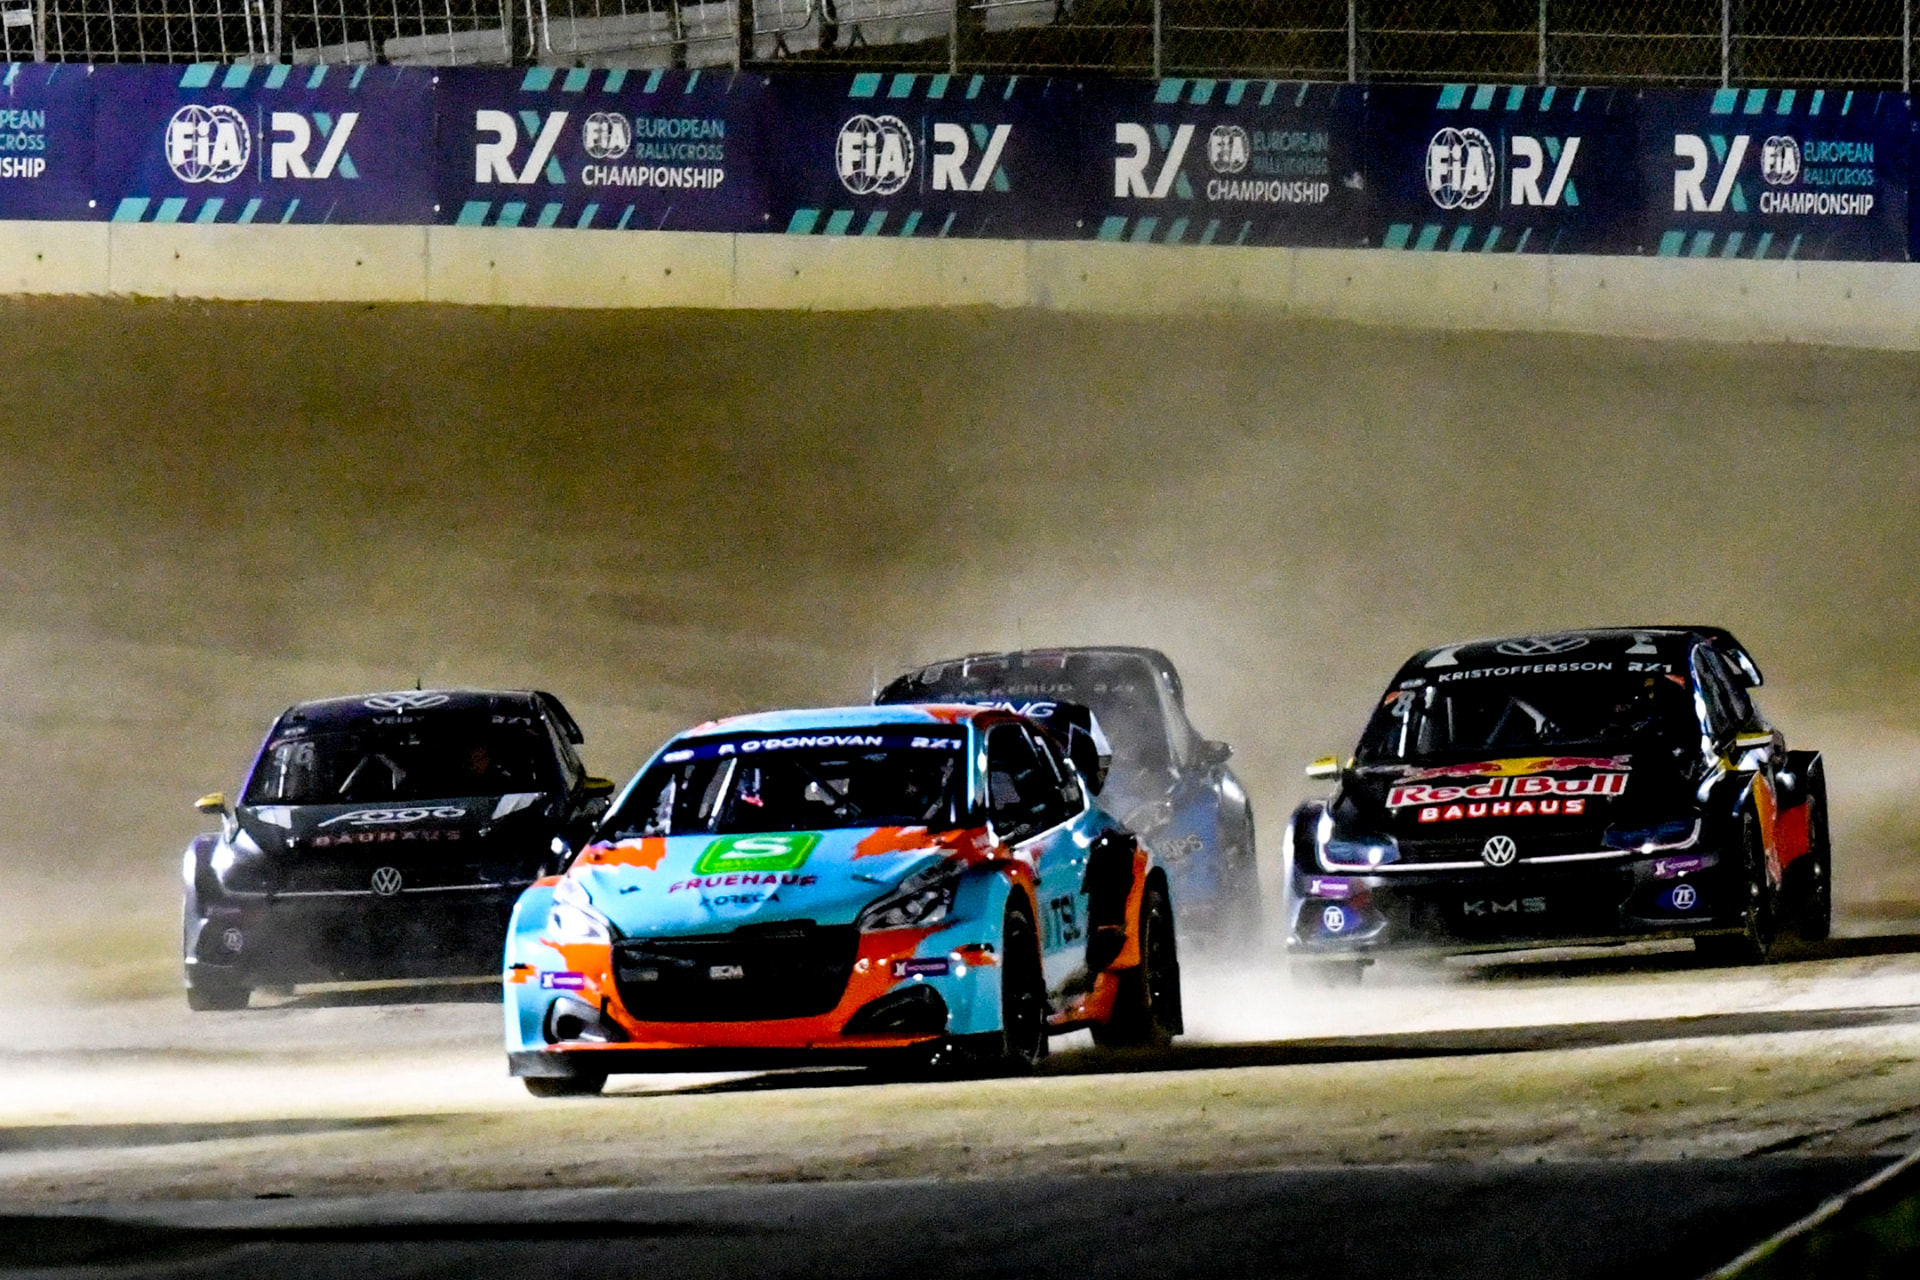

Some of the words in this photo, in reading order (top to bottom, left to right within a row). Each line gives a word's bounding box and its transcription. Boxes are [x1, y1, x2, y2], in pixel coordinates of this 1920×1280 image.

[636, 117, 725, 138] EUROPEAN
[271, 111, 360, 179] RX
[475, 110, 569, 184] RX
[636, 142, 725, 161] RALLYCROSS
[932, 122, 1013, 192] RX
[1803, 141, 1874, 163] EUROPEAN
[1114, 122, 1196, 198] RX
[1510, 135, 1581, 206] RX
[581, 164, 725, 189] CHAMPIONSHIP
[1673, 133, 1750, 212] RX
[1803, 167, 1874, 186] RALLYCROSS
[1206, 179, 1329, 204] CHAMPIONSHIP
[1759, 191, 1874, 215] CHAMPIONSHIP
[1438, 661, 1613, 683] KRISTOFFERSSON
[740, 734, 884, 753] O'DONOVAN
[1387, 778, 1510, 808] Red
[1509, 773, 1630, 797] Bull
[1420, 798, 1585, 822] BAUHAUS
[1462, 897, 1548, 916] KMS
